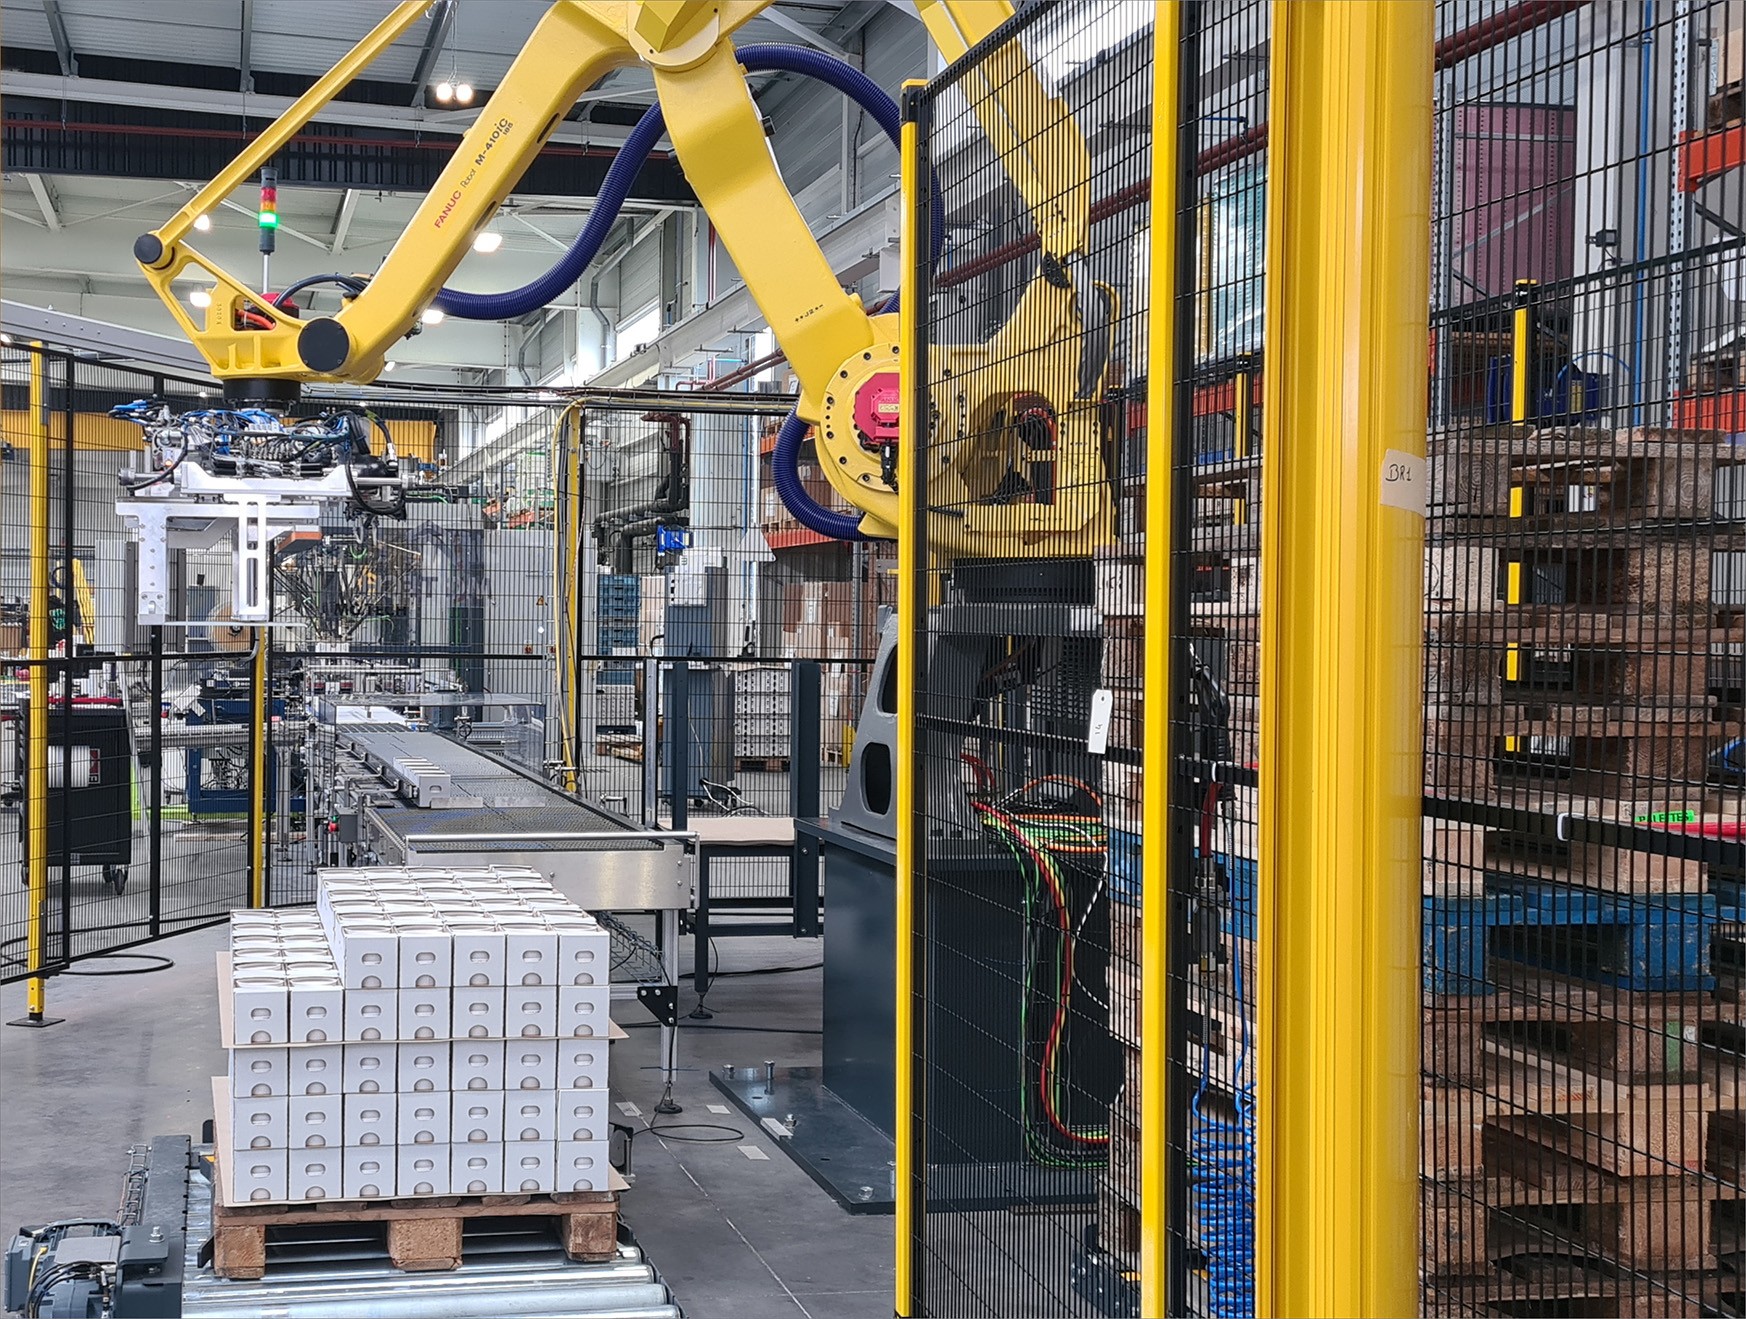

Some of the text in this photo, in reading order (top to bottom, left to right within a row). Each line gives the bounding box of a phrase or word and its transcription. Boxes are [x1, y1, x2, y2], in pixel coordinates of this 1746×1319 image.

[434, 189, 462, 229] FANUC
[461, 168, 477, 189] Robot
[1385, 463, 1412, 482] BR1
